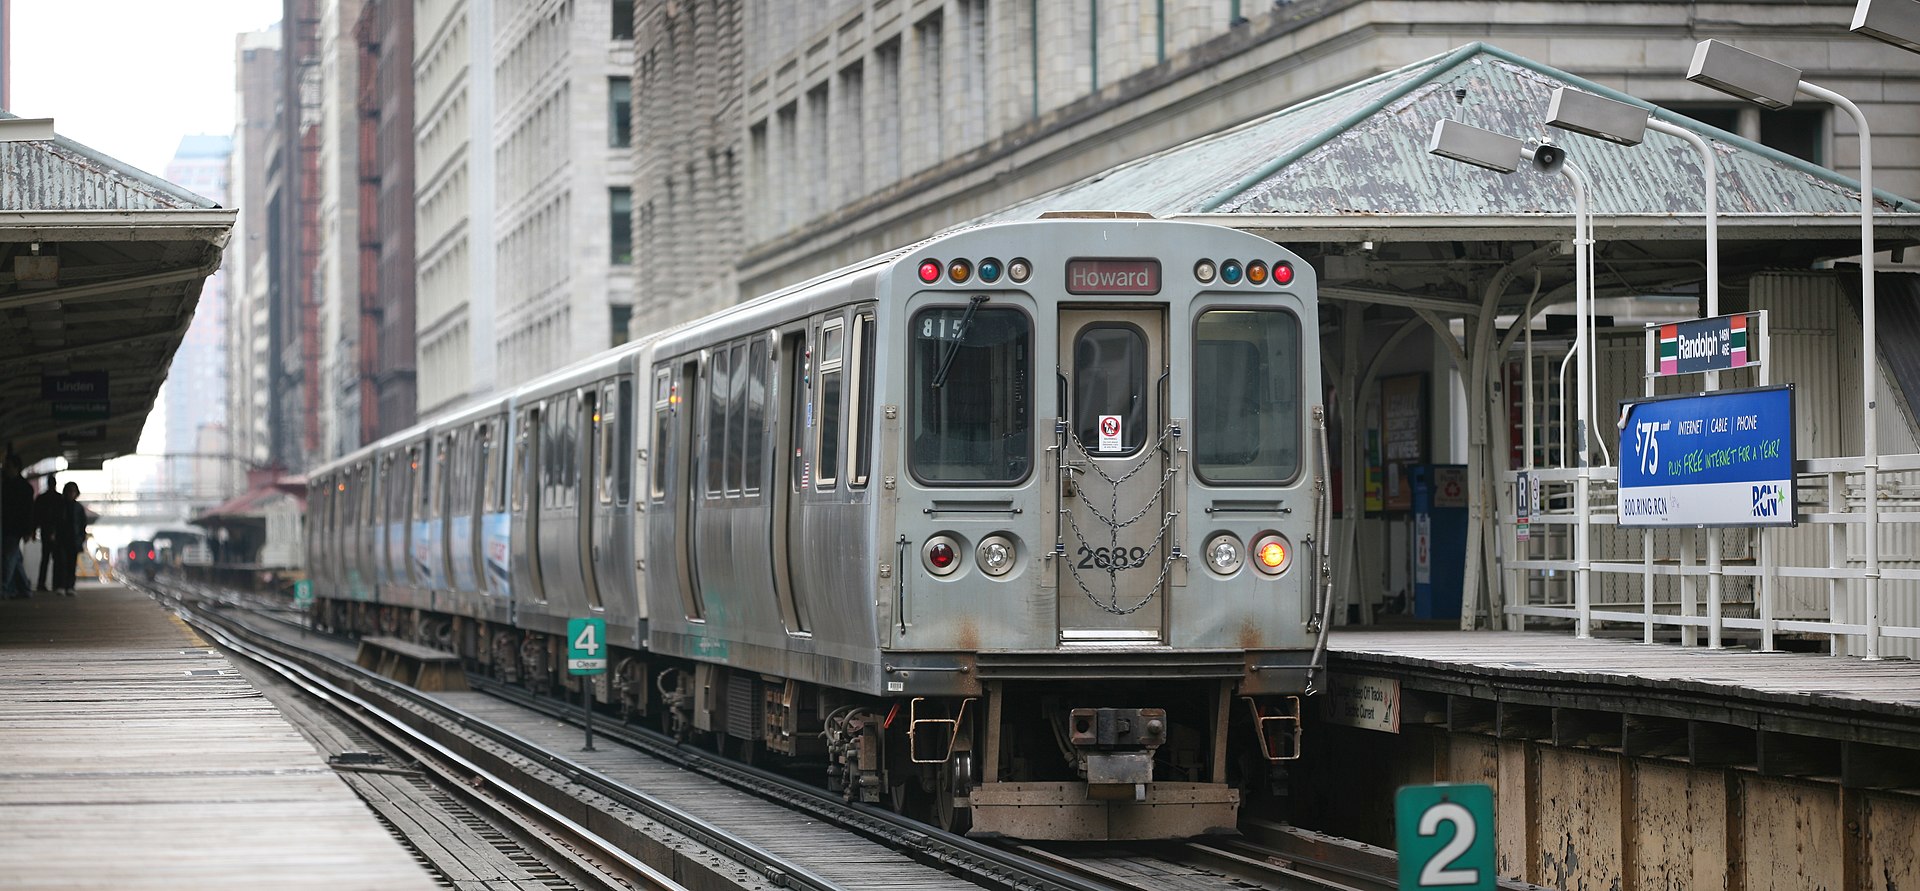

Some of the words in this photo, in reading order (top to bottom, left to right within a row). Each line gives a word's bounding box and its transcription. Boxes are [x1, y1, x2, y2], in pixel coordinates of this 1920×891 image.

[1072, 267, 1149, 288] Howard
[1718, 327, 1730, 342] 146N
[1678, 330, 1718, 363] Randolph
[1721, 342, 1730, 357] 46E
[56, 381, 95, 392] Linden
[1677, 419, 1703, 436] INTERNET
[1710, 417, 1728, 434] CABLE
[1736, 414, 1758, 431] PHONE
[1635, 418, 1660, 476] $75
[1667, 460, 1682, 476] PLUS
[1683, 450, 1703, 475] FREE
[1705, 449, 1737, 469] INTERNET
[1737, 445, 1751, 463] FOR
[1752, 449, 1758, 459] A
[1759, 438, 1781, 460] YEAR!
[1519, 477, 1526, 507] R
[1751, 484, 1778, 517] RCN
[1624, 496, 1668, 516] 800.RING.RCN
[1076, 545, 1146, 570] 2689
[574, 624, 599, 656] 4
[576, 660, 598, 669] Clear
[1363, 686, 1371, 700] Off
[1370, 686, 1384, 702] Tracks
[1359, 704, 1375, 720] Current
[1418, 802, 1479, 887] 2
